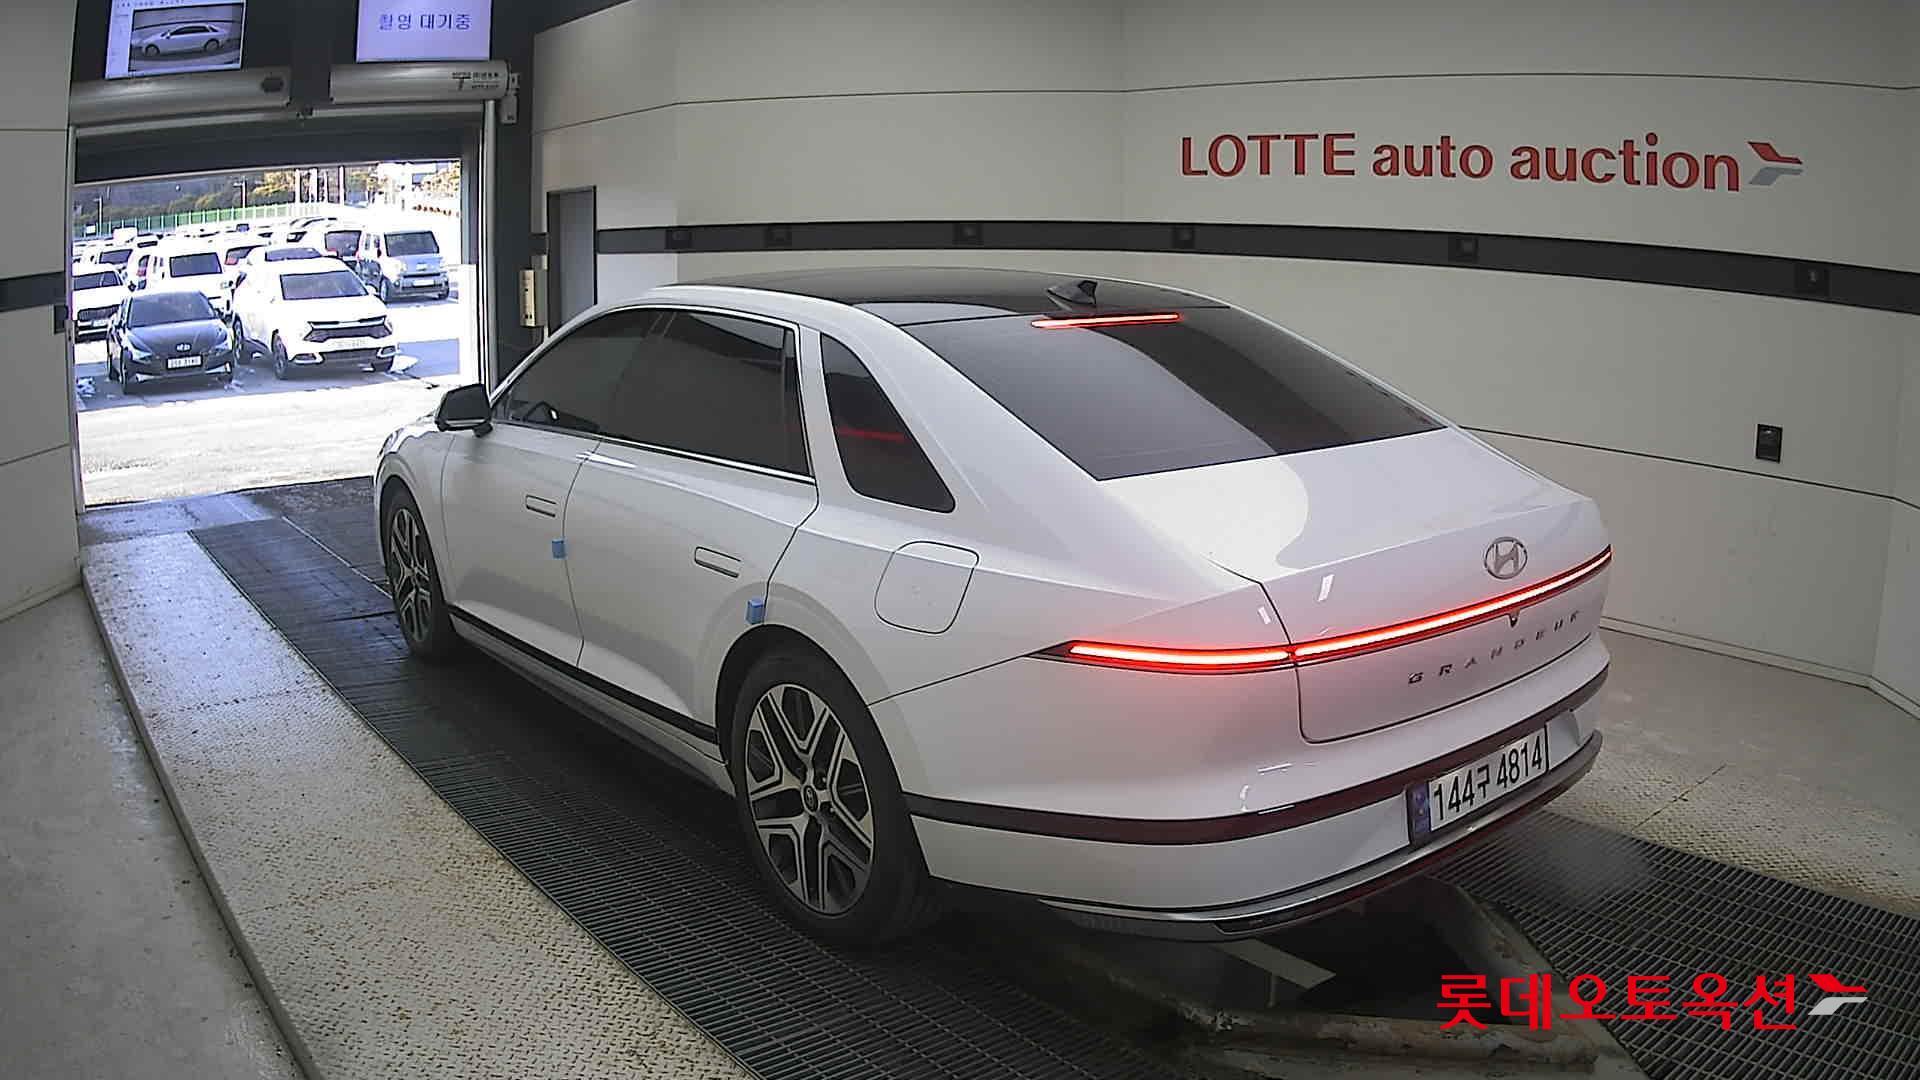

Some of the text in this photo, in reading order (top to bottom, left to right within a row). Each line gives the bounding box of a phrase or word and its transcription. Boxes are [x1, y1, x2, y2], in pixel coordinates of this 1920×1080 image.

[419, 13, 471, 30] 대기중
[1180, 132, 1741, 193] LOTTE auto auction
[1433, 735, 1543, 821] 144구 4814
